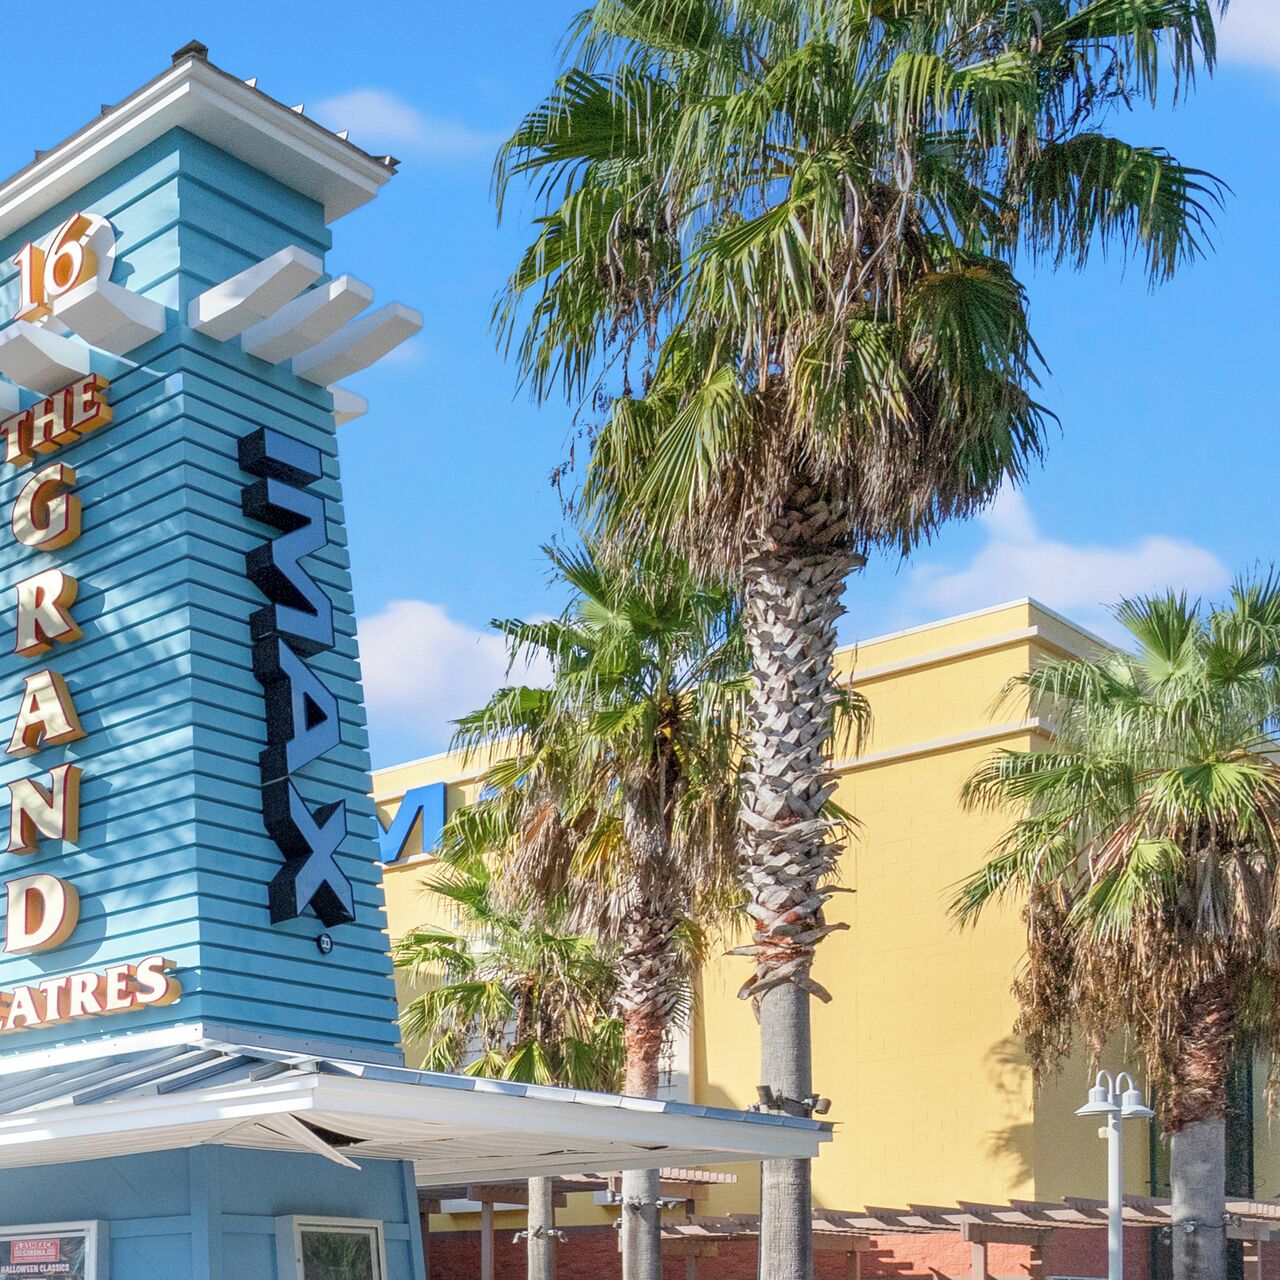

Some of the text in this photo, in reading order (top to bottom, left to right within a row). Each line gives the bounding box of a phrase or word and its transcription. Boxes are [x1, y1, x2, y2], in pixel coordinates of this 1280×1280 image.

[13, 210, 88, 321] 16
[0, 373, 104, 465] THE
[3, 462, 83, 955] GRAND
[252, 426, 356, 924] IMAX
[0, 1263, 70, 1273] HALLOWEEN CLASSICS
